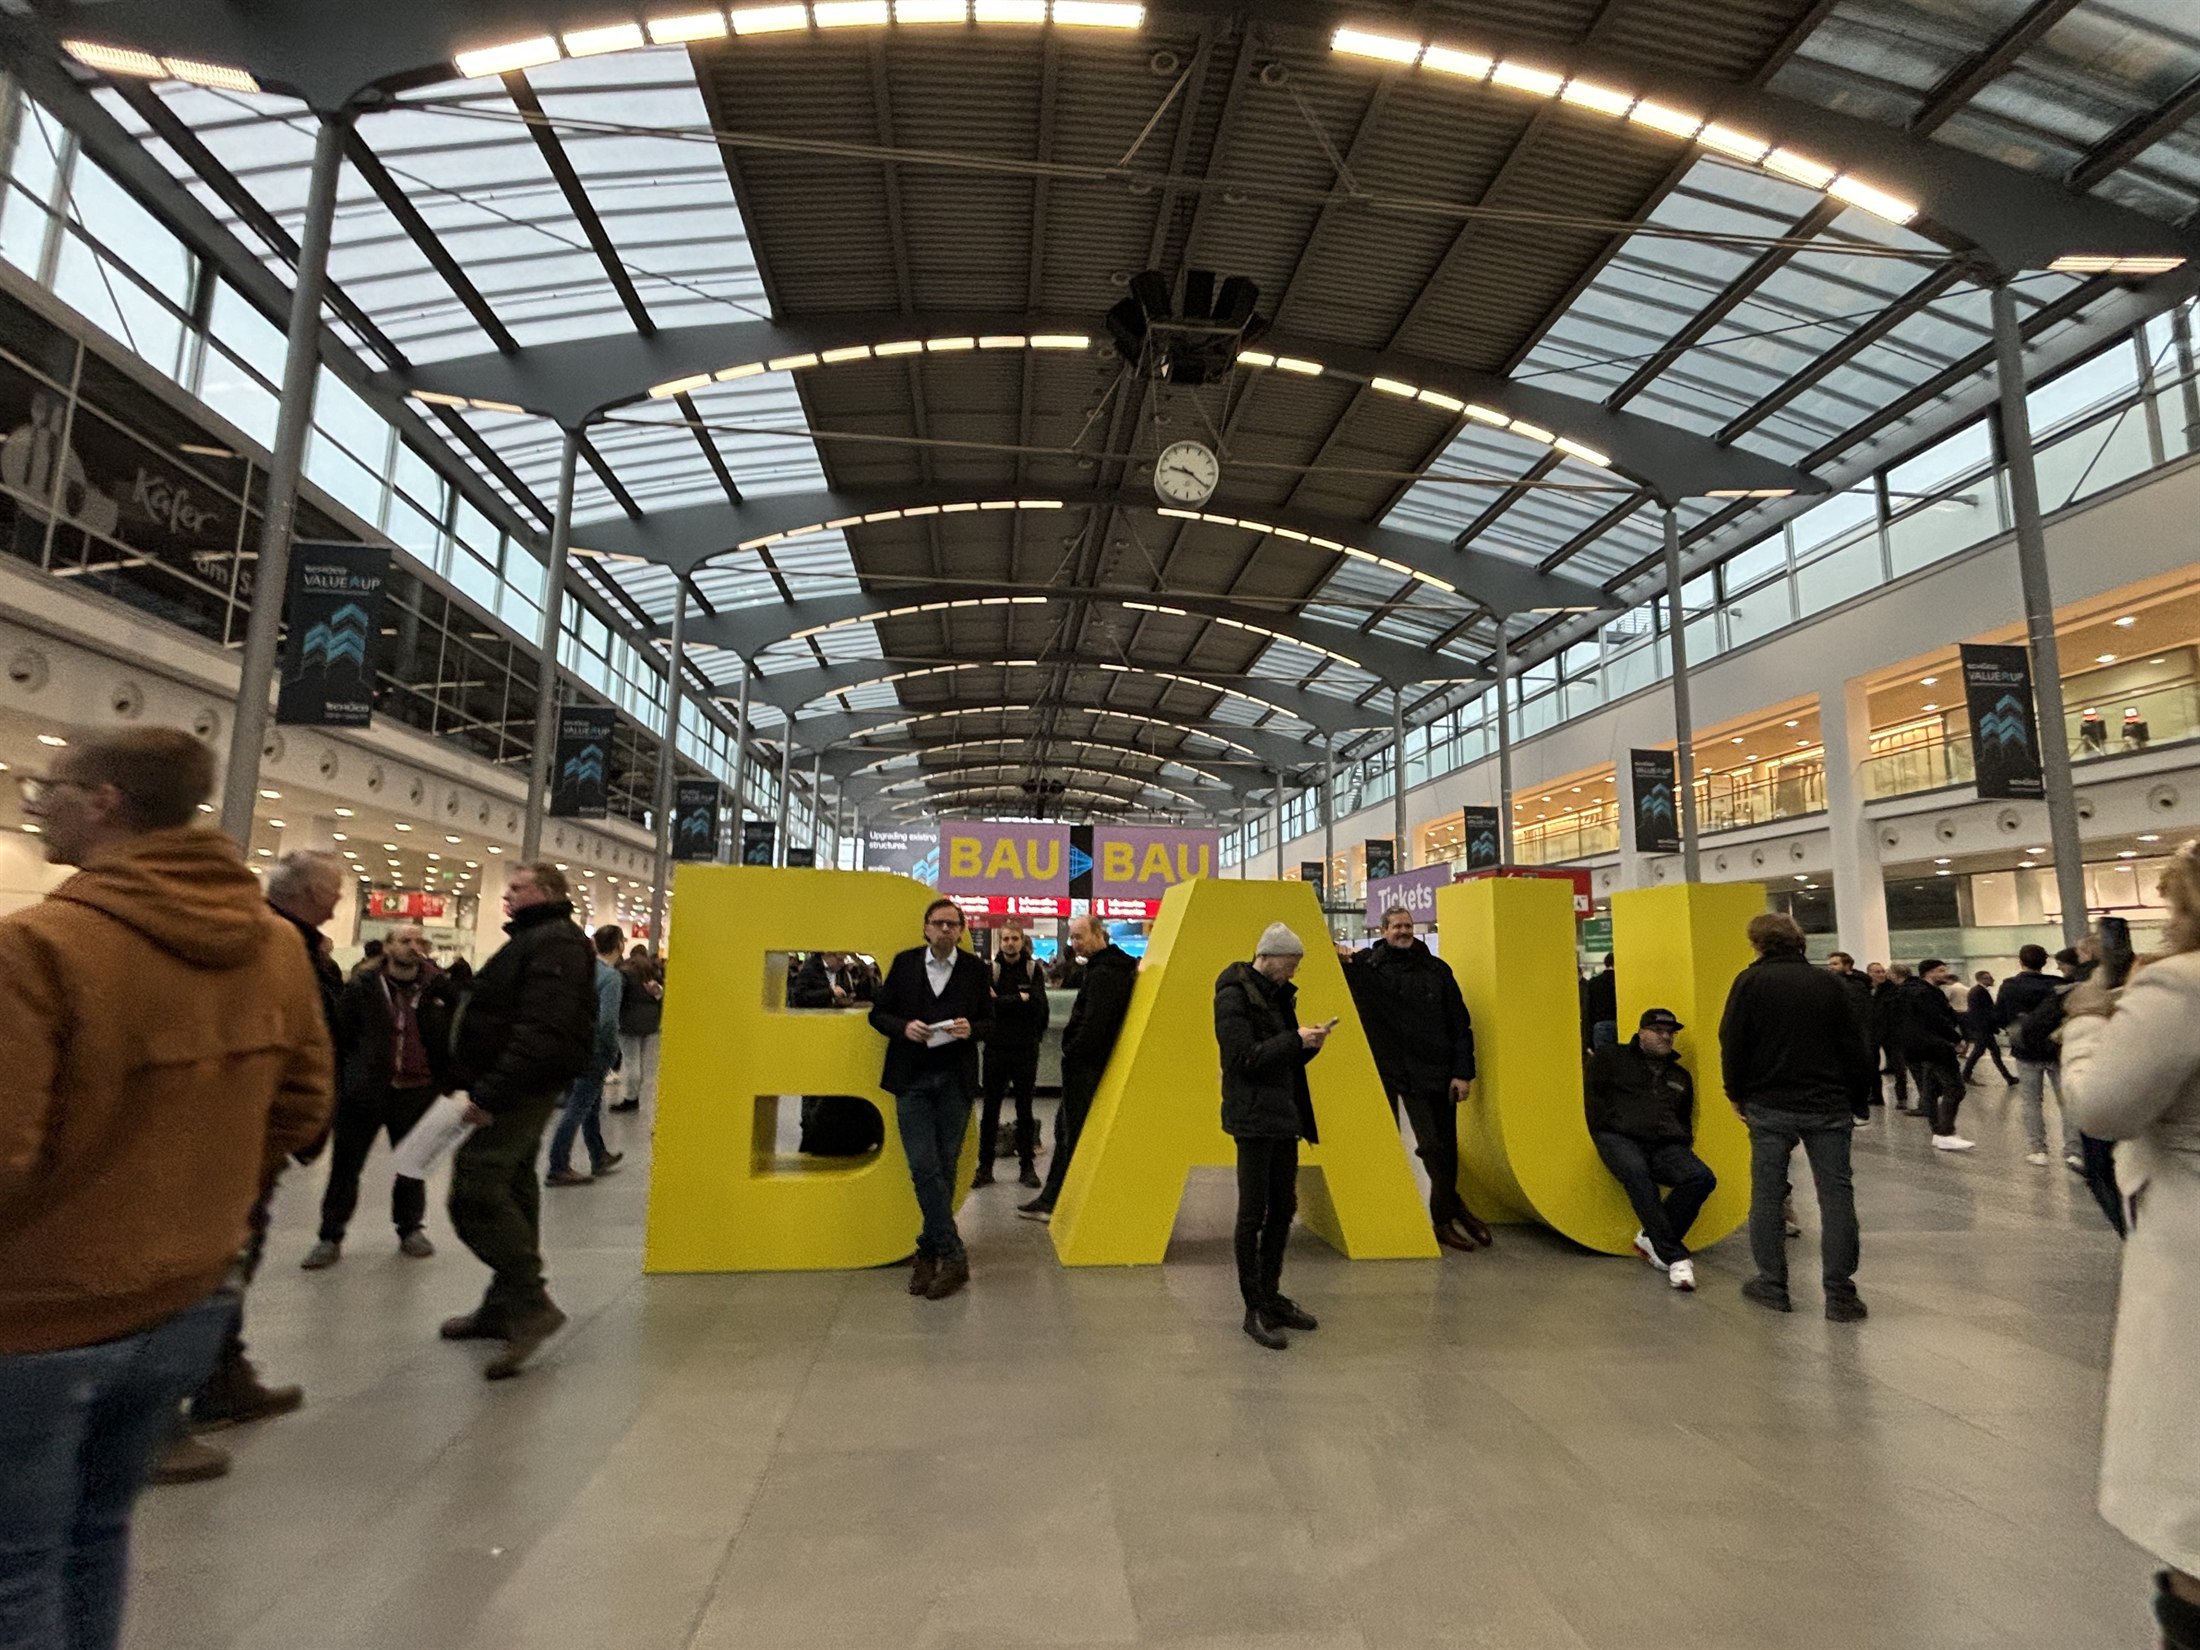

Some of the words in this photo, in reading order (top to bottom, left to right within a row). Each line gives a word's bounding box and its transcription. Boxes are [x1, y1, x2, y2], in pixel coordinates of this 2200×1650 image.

[303, 574, 348, 589] VALUE
[360, 578, 382, 590] UP
[1969, 671, 2001, 681] VALUE
[2010, 672, 2024, 682] UP
[869, 831, 907, 842] Upgrading
[909, 832, 937, 843] existing
[869, 840, 908, 850] structures.
[950, 837, 1060, 880] BAU
[1103, 842, 1210, 883] BAU
[1377, 883, 1433, 913] Tickets
[643, 863, 1768, 1274] BAU
